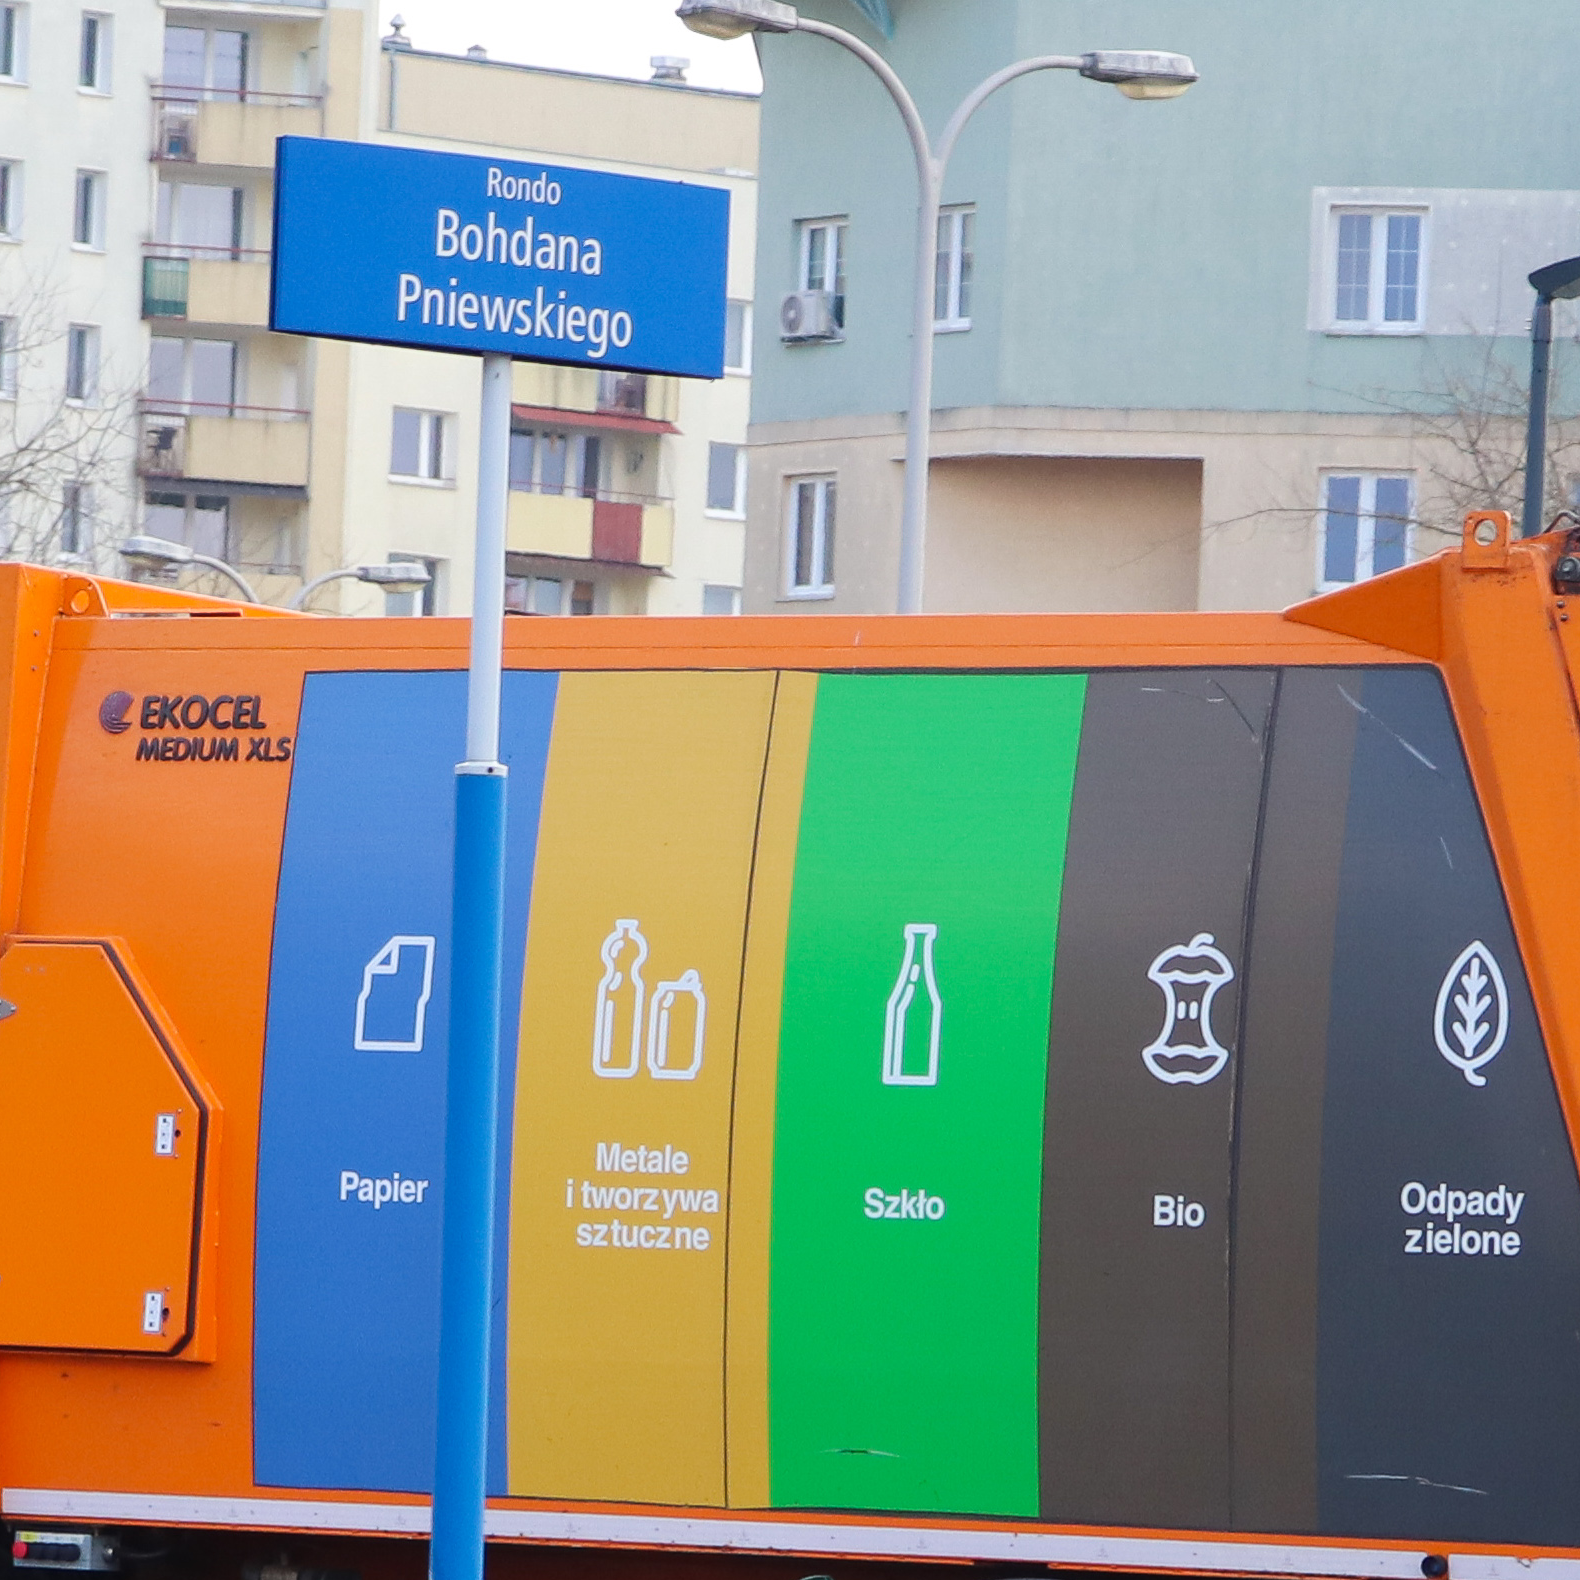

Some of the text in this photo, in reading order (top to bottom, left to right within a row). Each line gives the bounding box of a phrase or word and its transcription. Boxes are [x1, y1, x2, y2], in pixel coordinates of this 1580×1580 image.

[487, 166, 562, 205] Rondo
[435, 208, 603, 276] Bohdana
[397, 273, 633, 359] Pniewskiego
[140, 695, 267, 729] EKOCEL
[135, 737, 292, 762] MEDIUM XLS
[595, 1142, 690, 1175] Metale
[339, 1171, 429, 1209] Papier
[565, 1179, 719, 1219] i tworzywa
[863, 1187, 946, 1220] Szkło
[1400, 1181, 1525, 1225] Odpady
[1152, 1195, 1206, 1227] Bio
[576, 1219, 711, 1251] sztuczne
[1404, 1223, 1522, 1256] zielone
